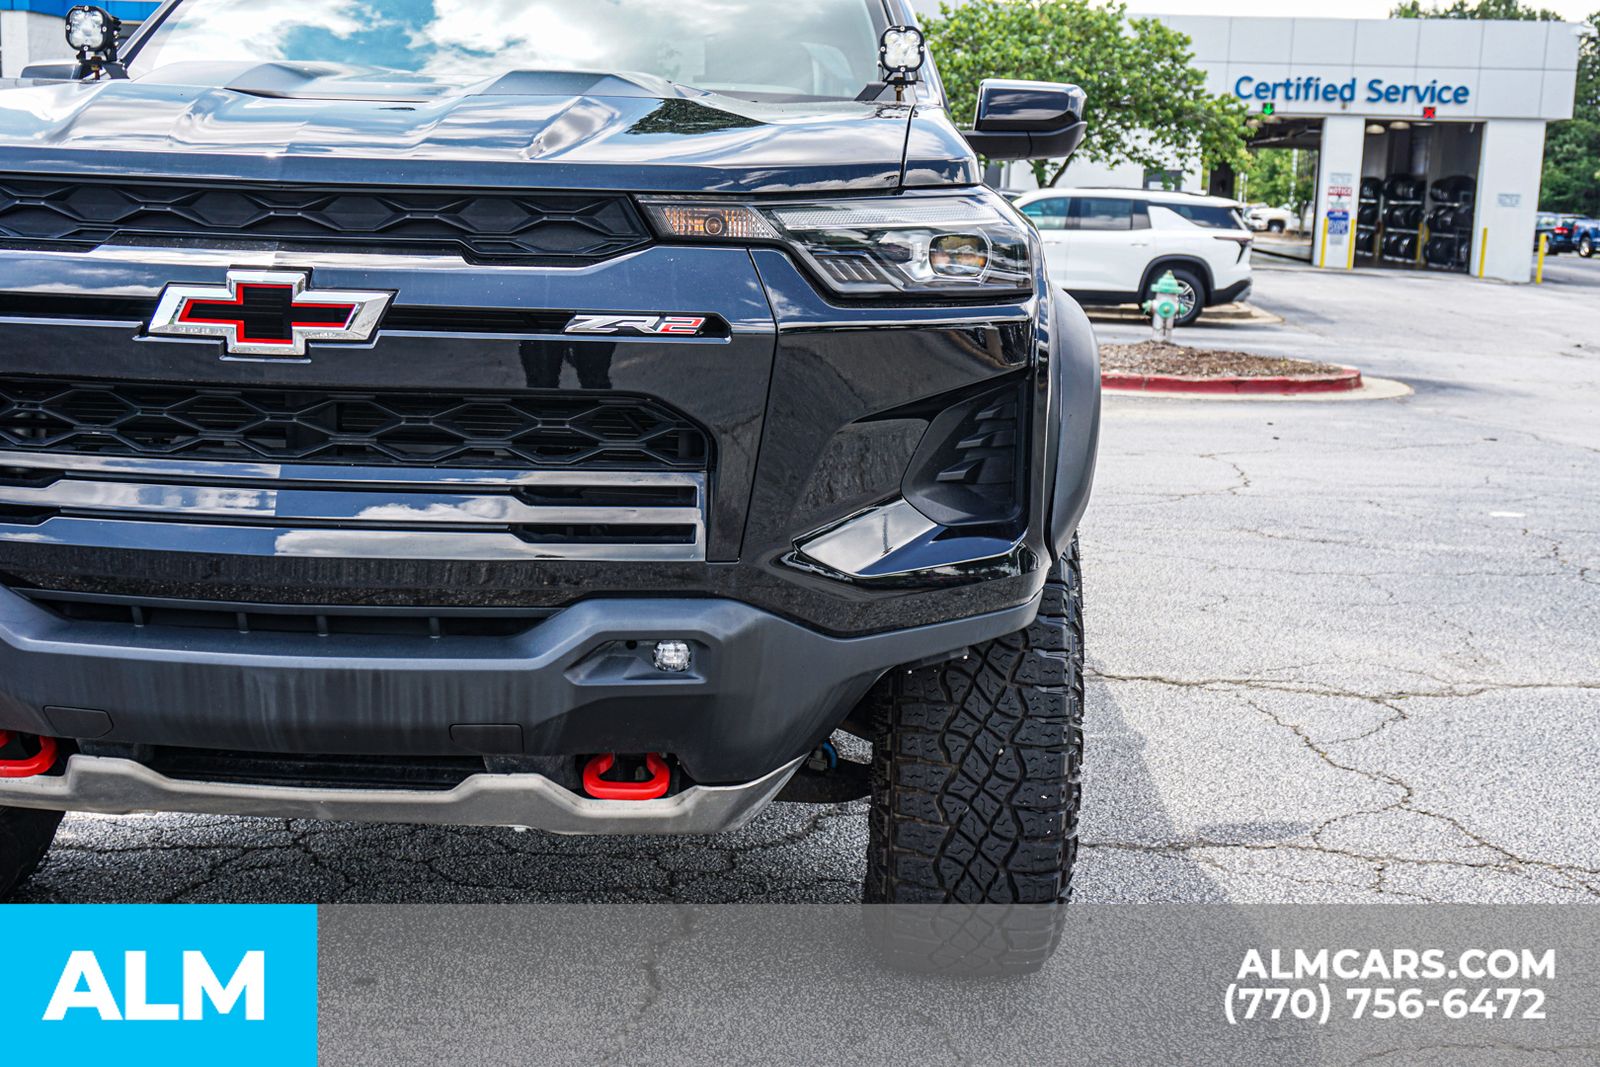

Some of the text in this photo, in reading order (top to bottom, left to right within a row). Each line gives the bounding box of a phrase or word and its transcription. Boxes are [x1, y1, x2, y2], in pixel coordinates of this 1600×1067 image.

[1235, 75, 1470, 104] Certified Service
[564, 314, 706, 335] ZR2
